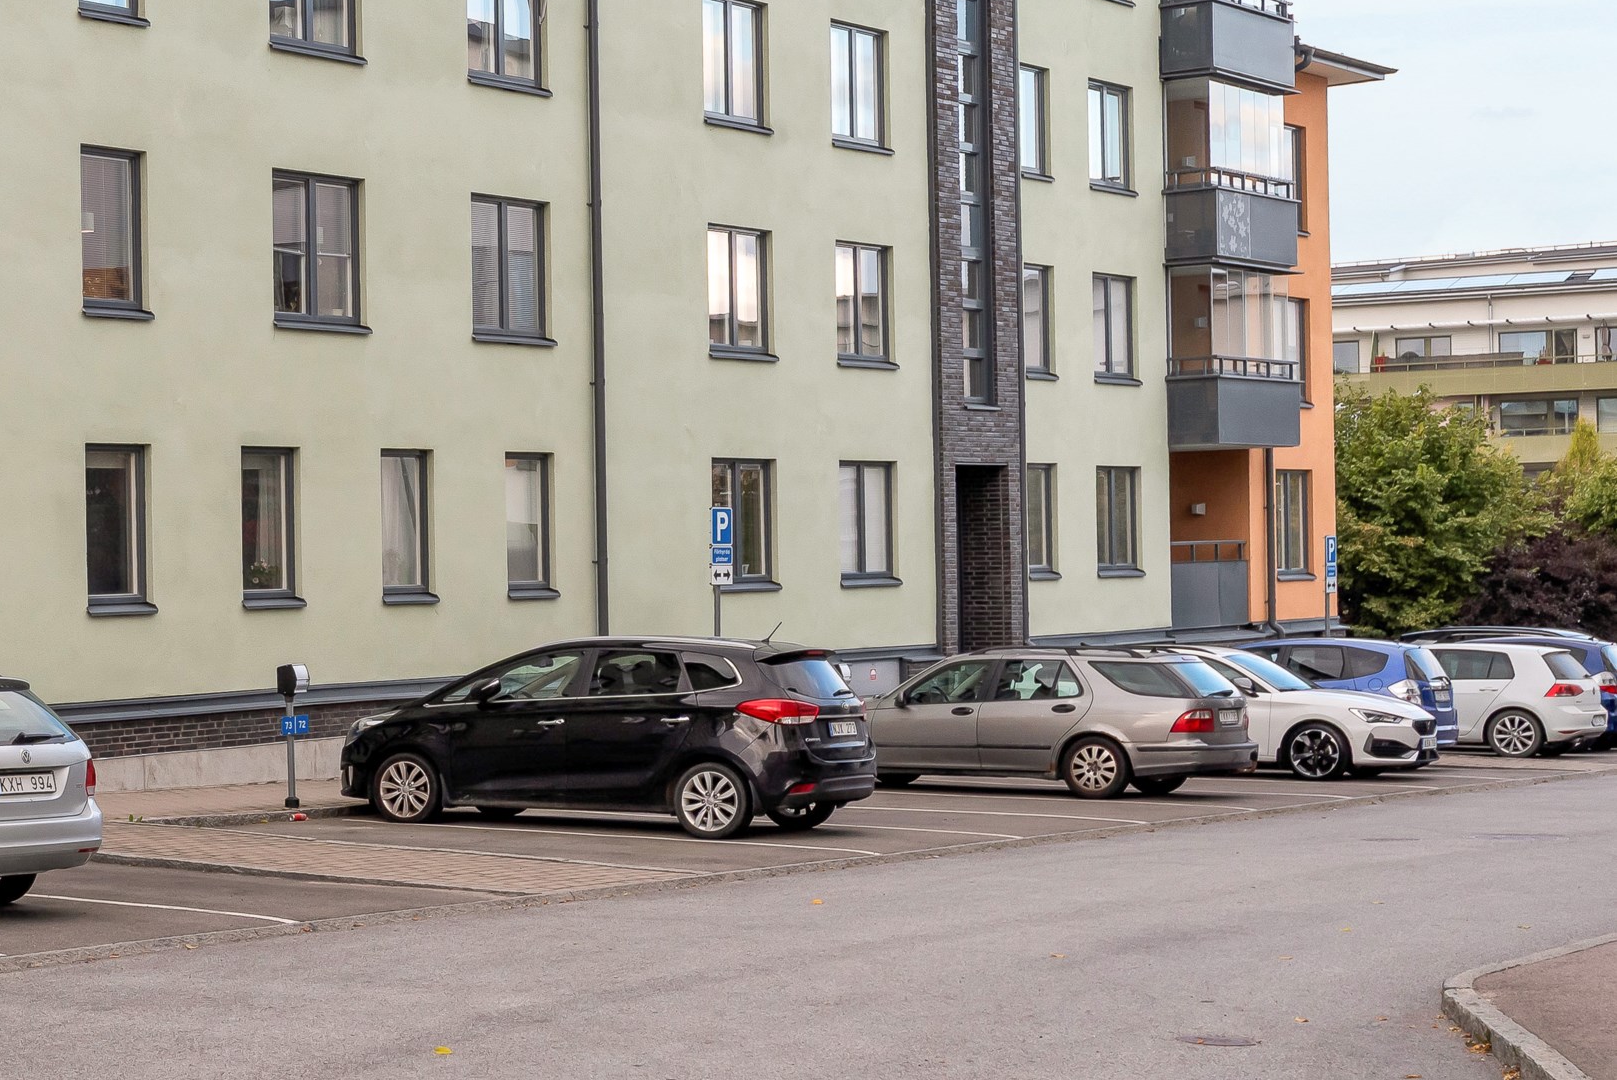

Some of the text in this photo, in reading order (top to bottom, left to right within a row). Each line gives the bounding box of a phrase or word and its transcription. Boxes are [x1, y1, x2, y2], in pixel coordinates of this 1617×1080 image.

[716, 511, 729, 542] P
[1328, 538, 1335, 561] P
[284, 720, 306, 730] 73 72
[0, 776, 53, 792] KXH 994
